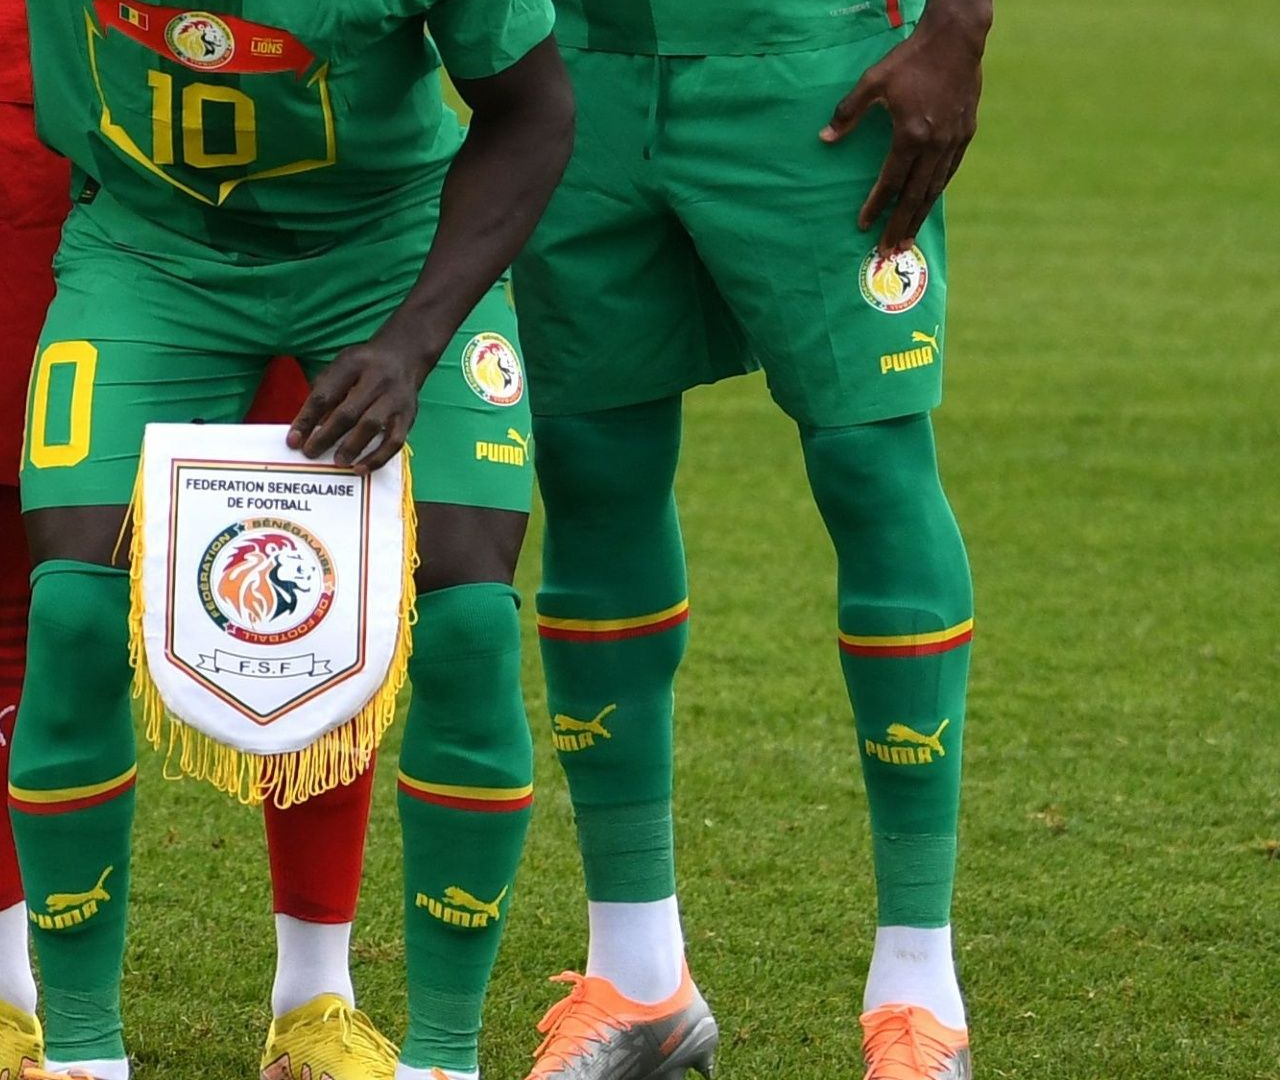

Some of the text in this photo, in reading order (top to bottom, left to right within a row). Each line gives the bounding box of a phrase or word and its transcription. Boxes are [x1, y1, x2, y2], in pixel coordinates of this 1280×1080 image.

[251, 41, 283, 54] LIONS
[148, 69, 257, 169] 10
[880, 346, 933, 374] PUMA
[476, 441, 524, 467] PUMA
[186, 478, 355, 497] FEDERATION SENEGALAISE
[227, 497, 312, 512] DE FOOTBALL
[243, 618, 316, 643] FOOTBALL
[239, 660, 291, 675] F.S.F
[552, 730, 595, 752] UMA
[865, 739, 932, 764] PUMA
[415, 892, 488, 927] PUMA
